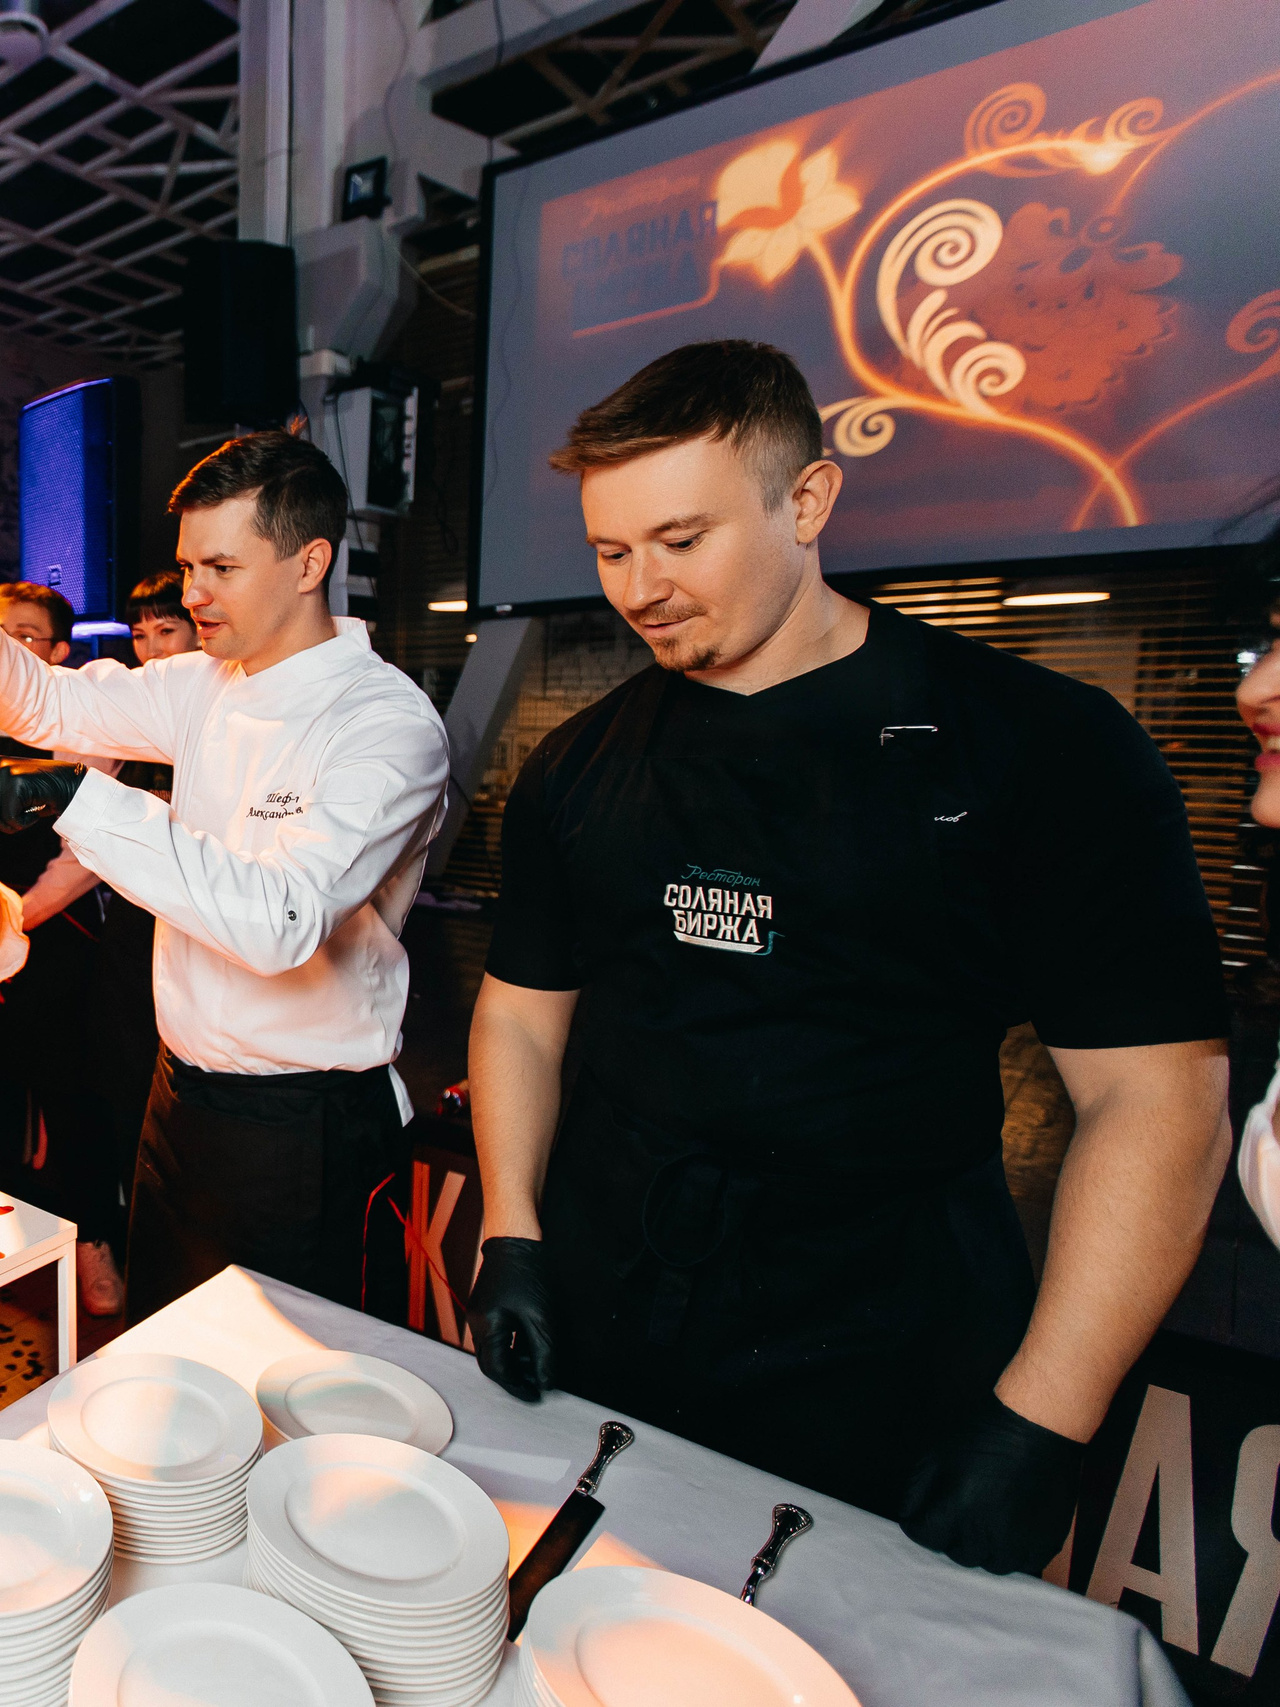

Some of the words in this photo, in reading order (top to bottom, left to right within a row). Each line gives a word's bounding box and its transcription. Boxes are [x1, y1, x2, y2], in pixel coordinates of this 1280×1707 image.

[680, 863, 761, 888] Ресторан
[663, 883, 773, 920] СОЛЯНАЯ
[672, 909, 761, 944] БИРЖА
